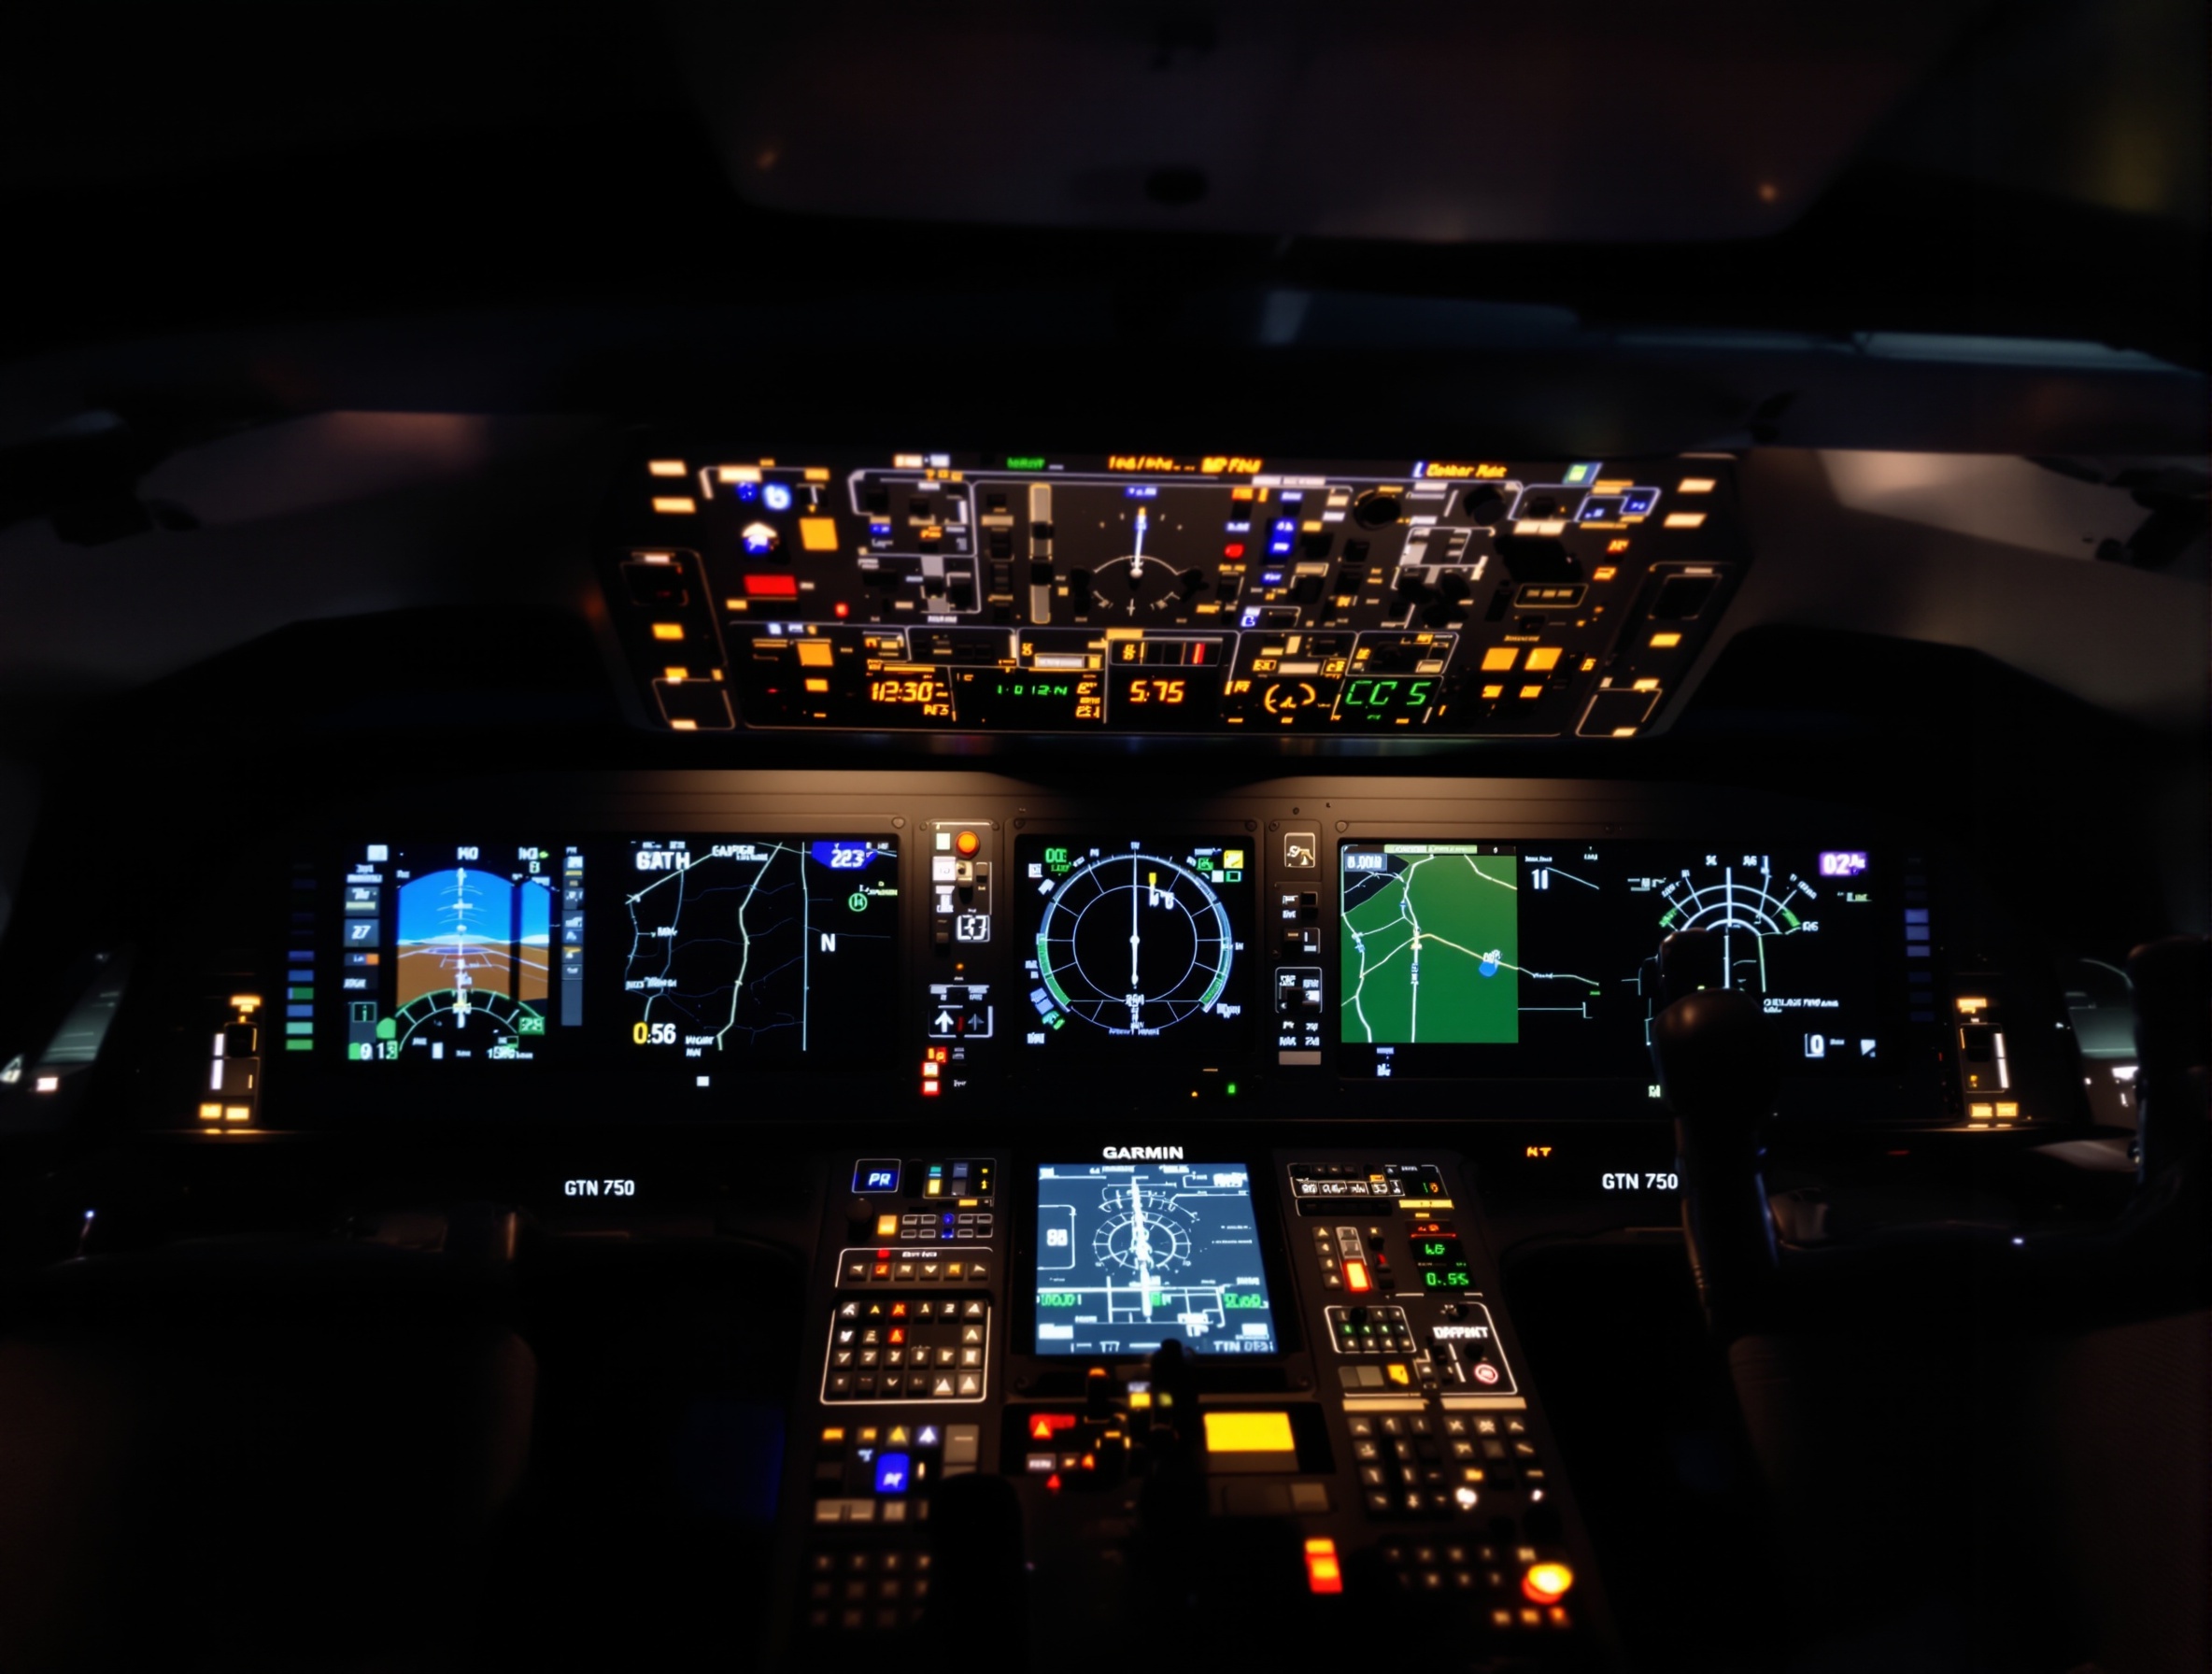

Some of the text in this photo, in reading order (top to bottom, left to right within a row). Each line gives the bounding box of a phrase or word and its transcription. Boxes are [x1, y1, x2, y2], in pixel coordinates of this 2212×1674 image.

[820, 933, 836, 952] N
[633, 1021, 676, 1044] 0:56
[1102, 1146, 1184, 1160] GARMIN
[564, 1179, 635, 1196] GTN 750
[869, 1172, 891, 1186] PR
[1602, 1172, 1679, 1190] GTN 750
